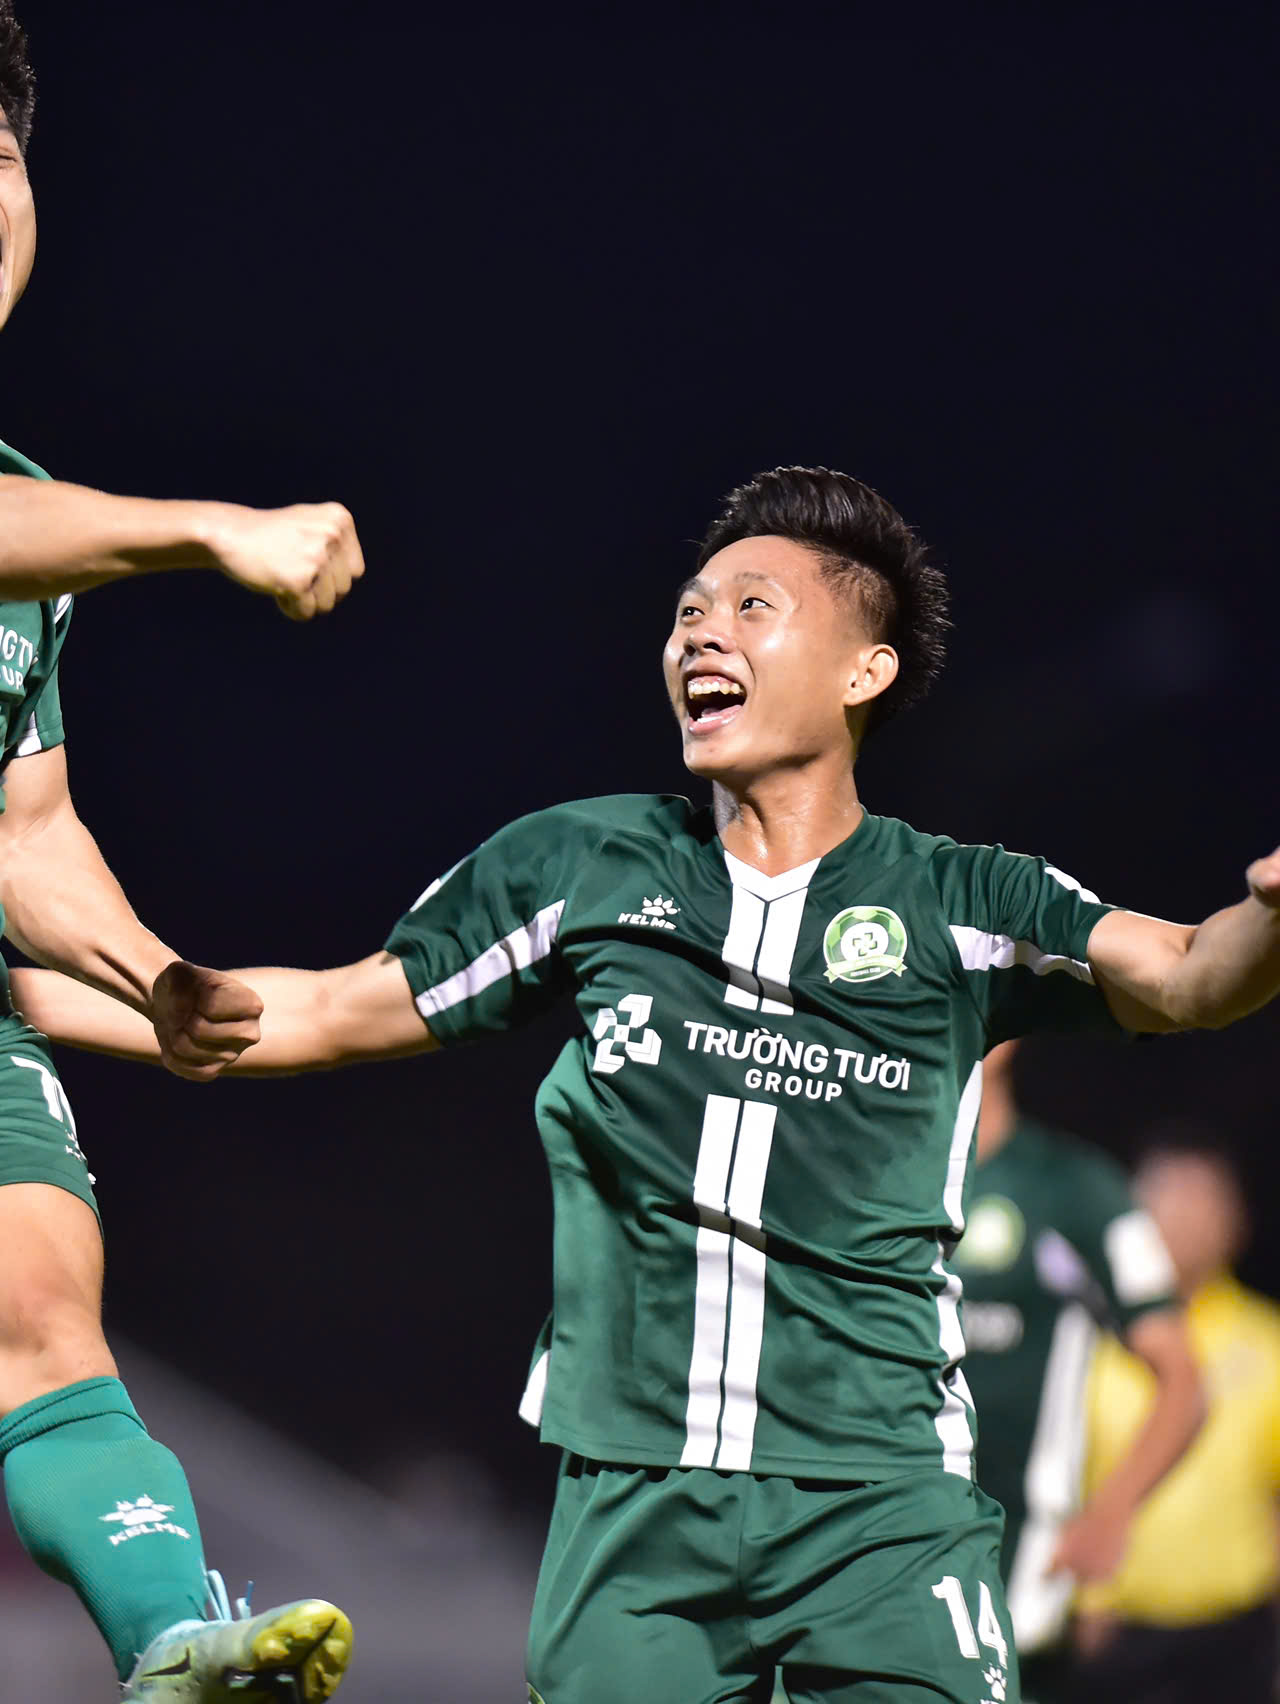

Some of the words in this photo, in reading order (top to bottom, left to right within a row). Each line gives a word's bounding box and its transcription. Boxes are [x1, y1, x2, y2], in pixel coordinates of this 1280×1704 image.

[683, 1019, 829, 1074] TRƯỜNG
[833, 1047, 912, 1092] TƯƠI
[744, 1067, 843, 1102] GROUP
[931, 1575, 1009, 1671] 14
